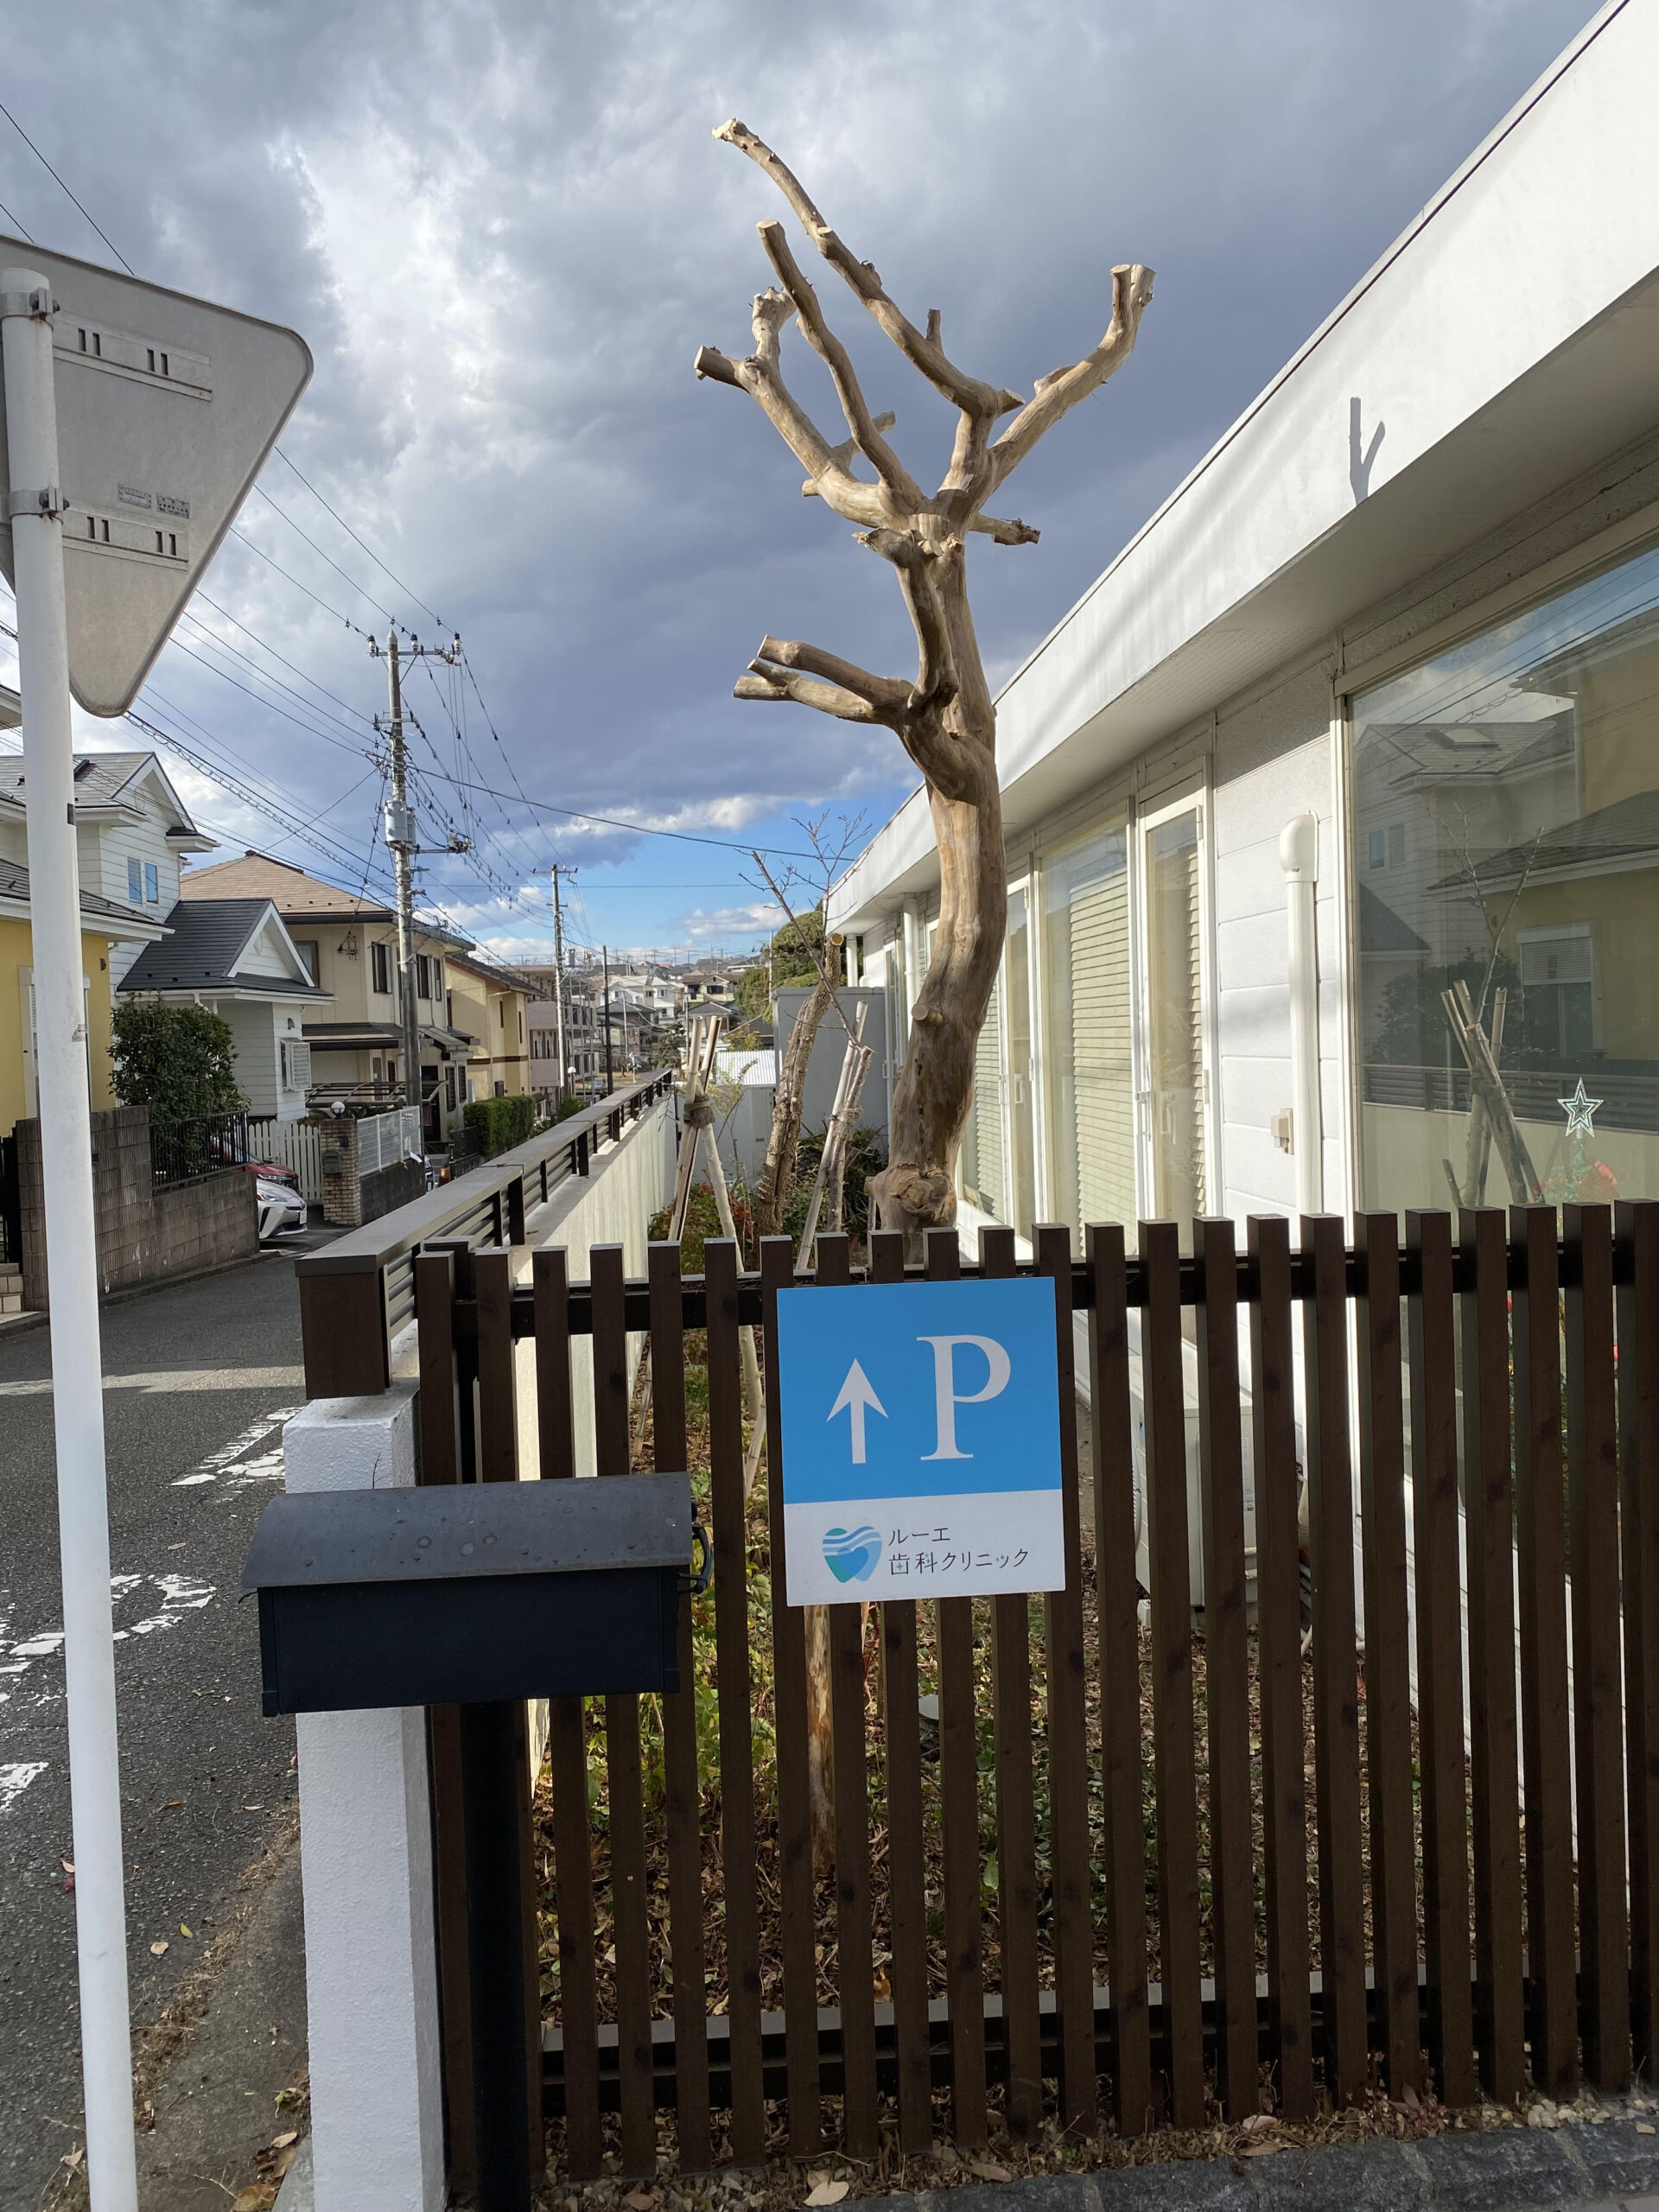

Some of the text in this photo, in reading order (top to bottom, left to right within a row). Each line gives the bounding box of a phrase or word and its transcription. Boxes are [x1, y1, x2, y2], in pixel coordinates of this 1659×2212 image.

[916, 1334, 1011, 1461] P
[888, 1527, 951, 1547] ルーエ
[888, 1548, 1028, 1576] 歯科クリニック
